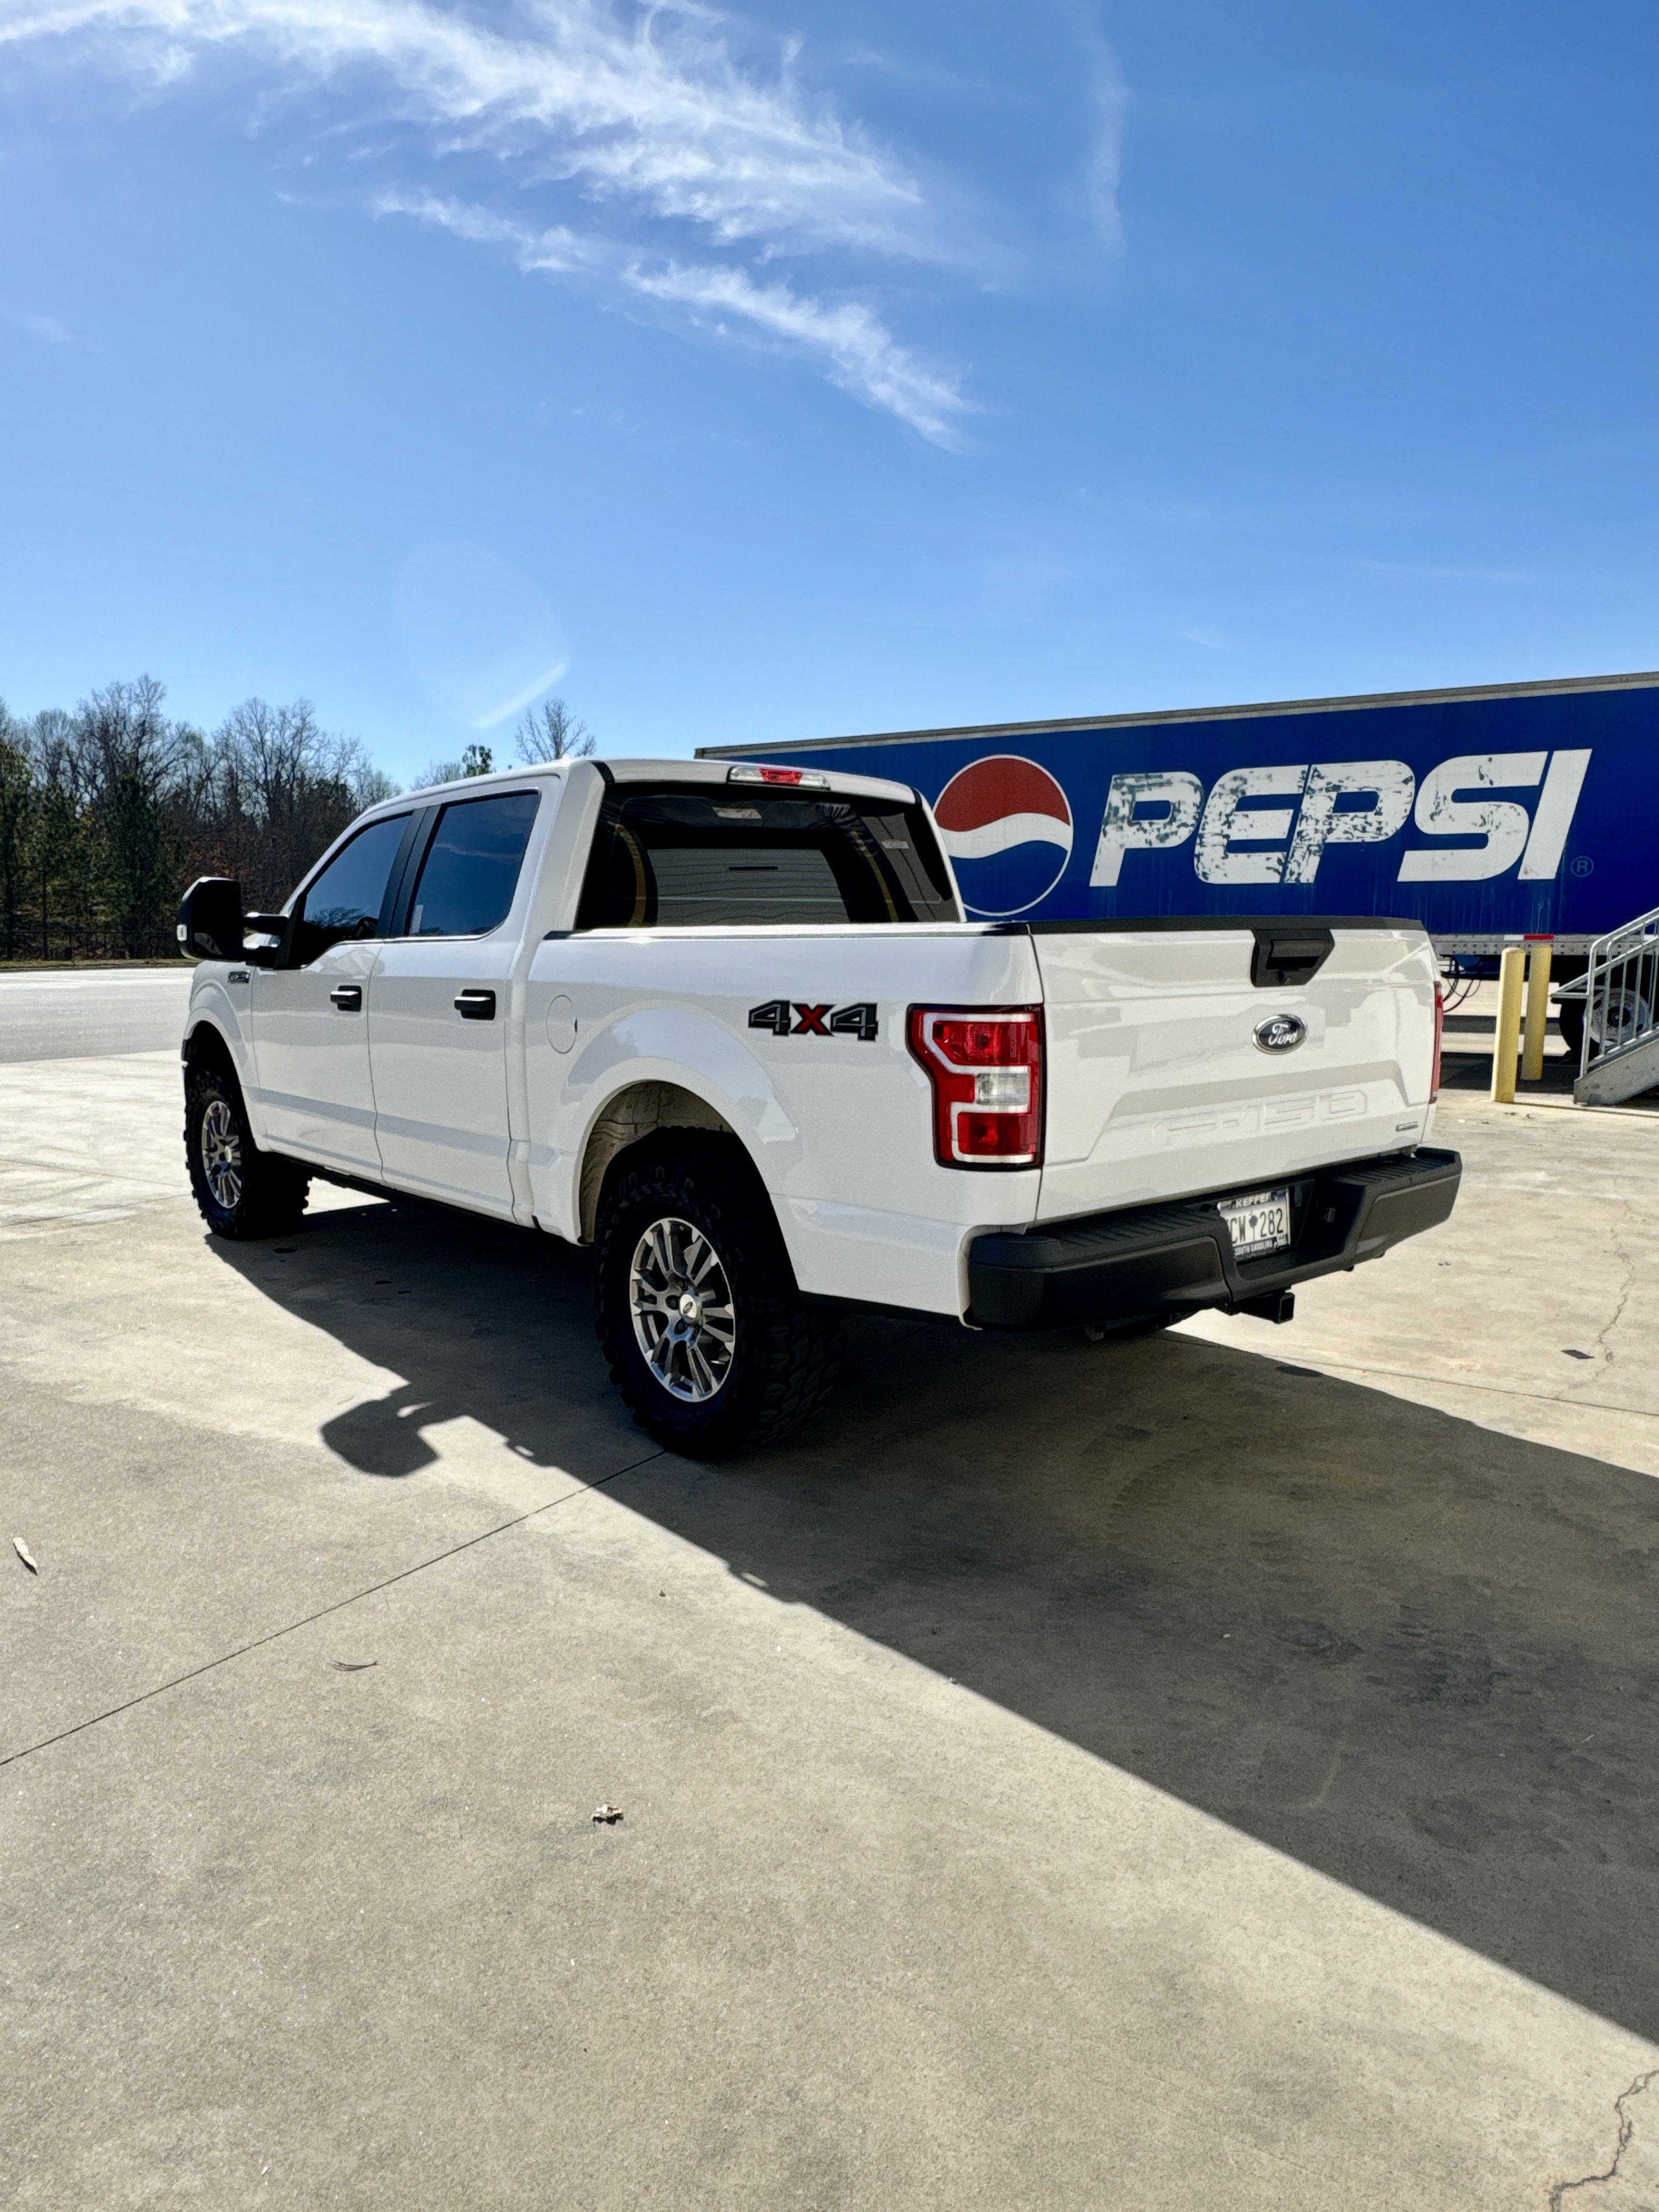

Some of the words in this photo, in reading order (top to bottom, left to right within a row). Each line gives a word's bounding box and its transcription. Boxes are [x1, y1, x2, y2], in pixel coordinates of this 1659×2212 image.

[1088, 748, 1593, 887] PEPSI
[1268, 1023, 1298, 1046] Ford
[1227, 1215, 1246, 1244] CW
[1260, 1208, 1284, 1237] 282
